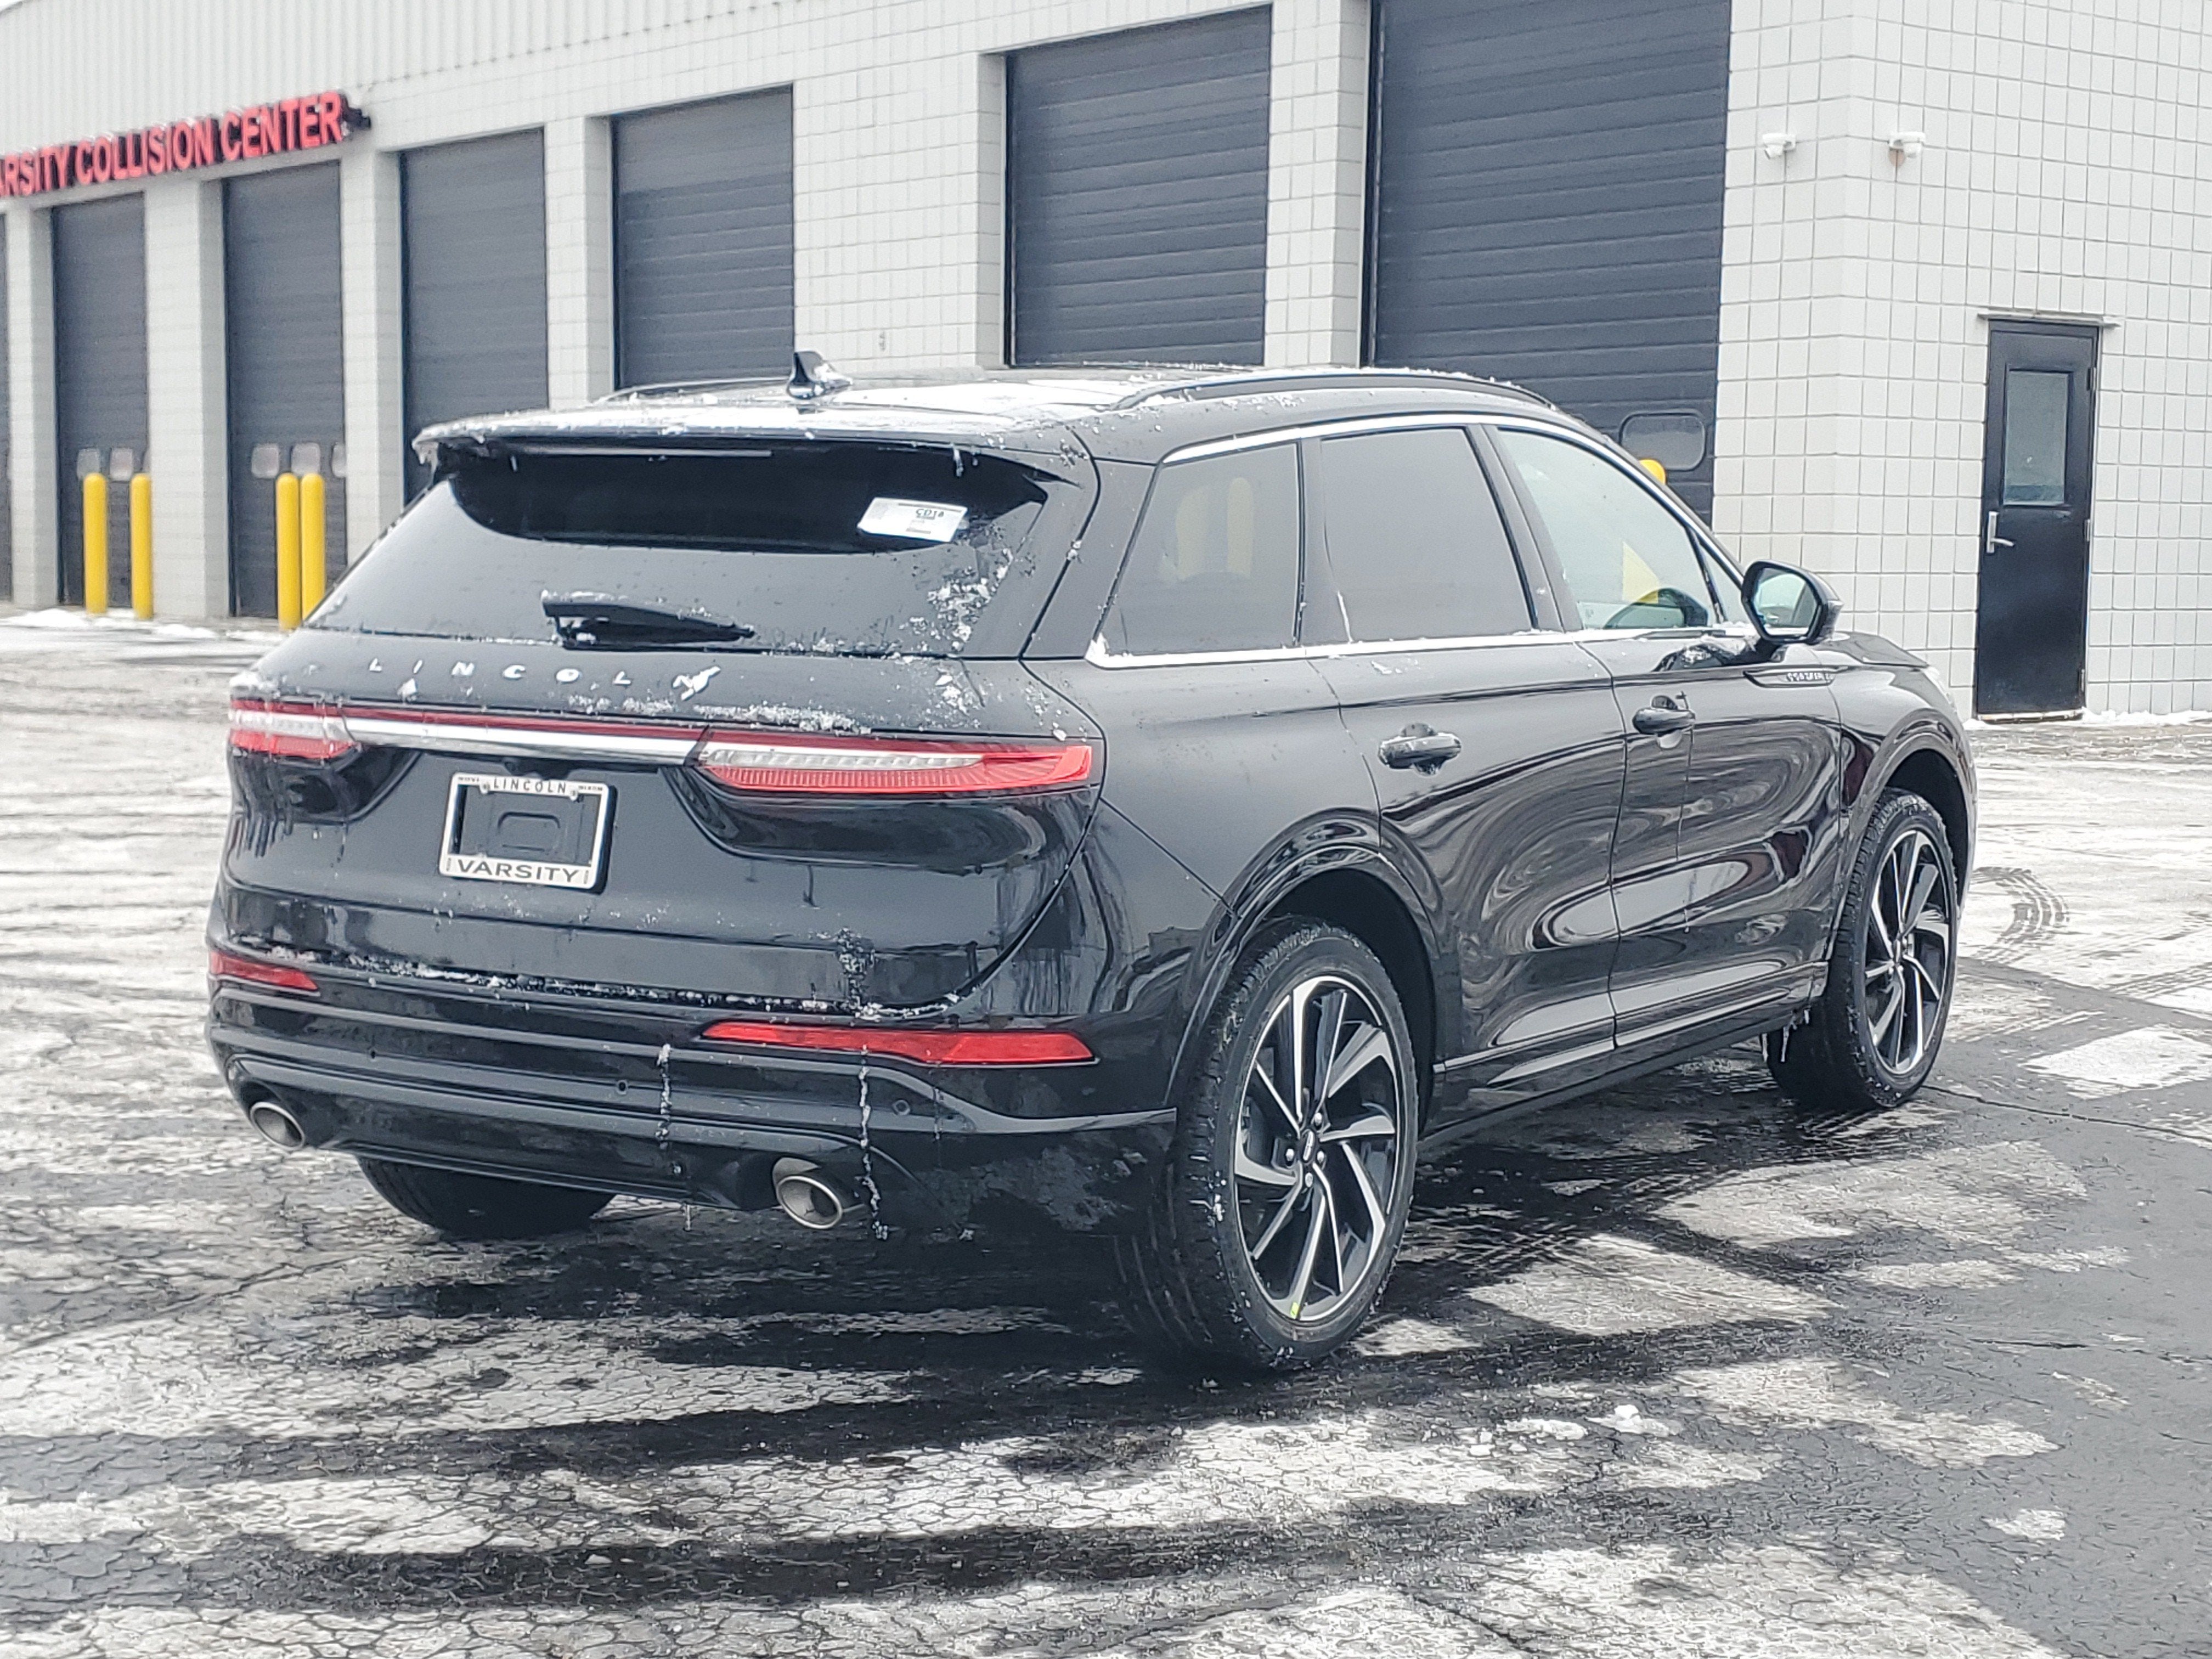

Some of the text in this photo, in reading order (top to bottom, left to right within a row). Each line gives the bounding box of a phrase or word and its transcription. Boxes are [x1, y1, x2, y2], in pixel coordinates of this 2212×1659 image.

[75, 116, 216, 185] COLLISION
[221, 90, 342, 161] CENTER
[493, 777, 566, 794] LINCOLN
[457, 859, 579, 882] VARSITY
